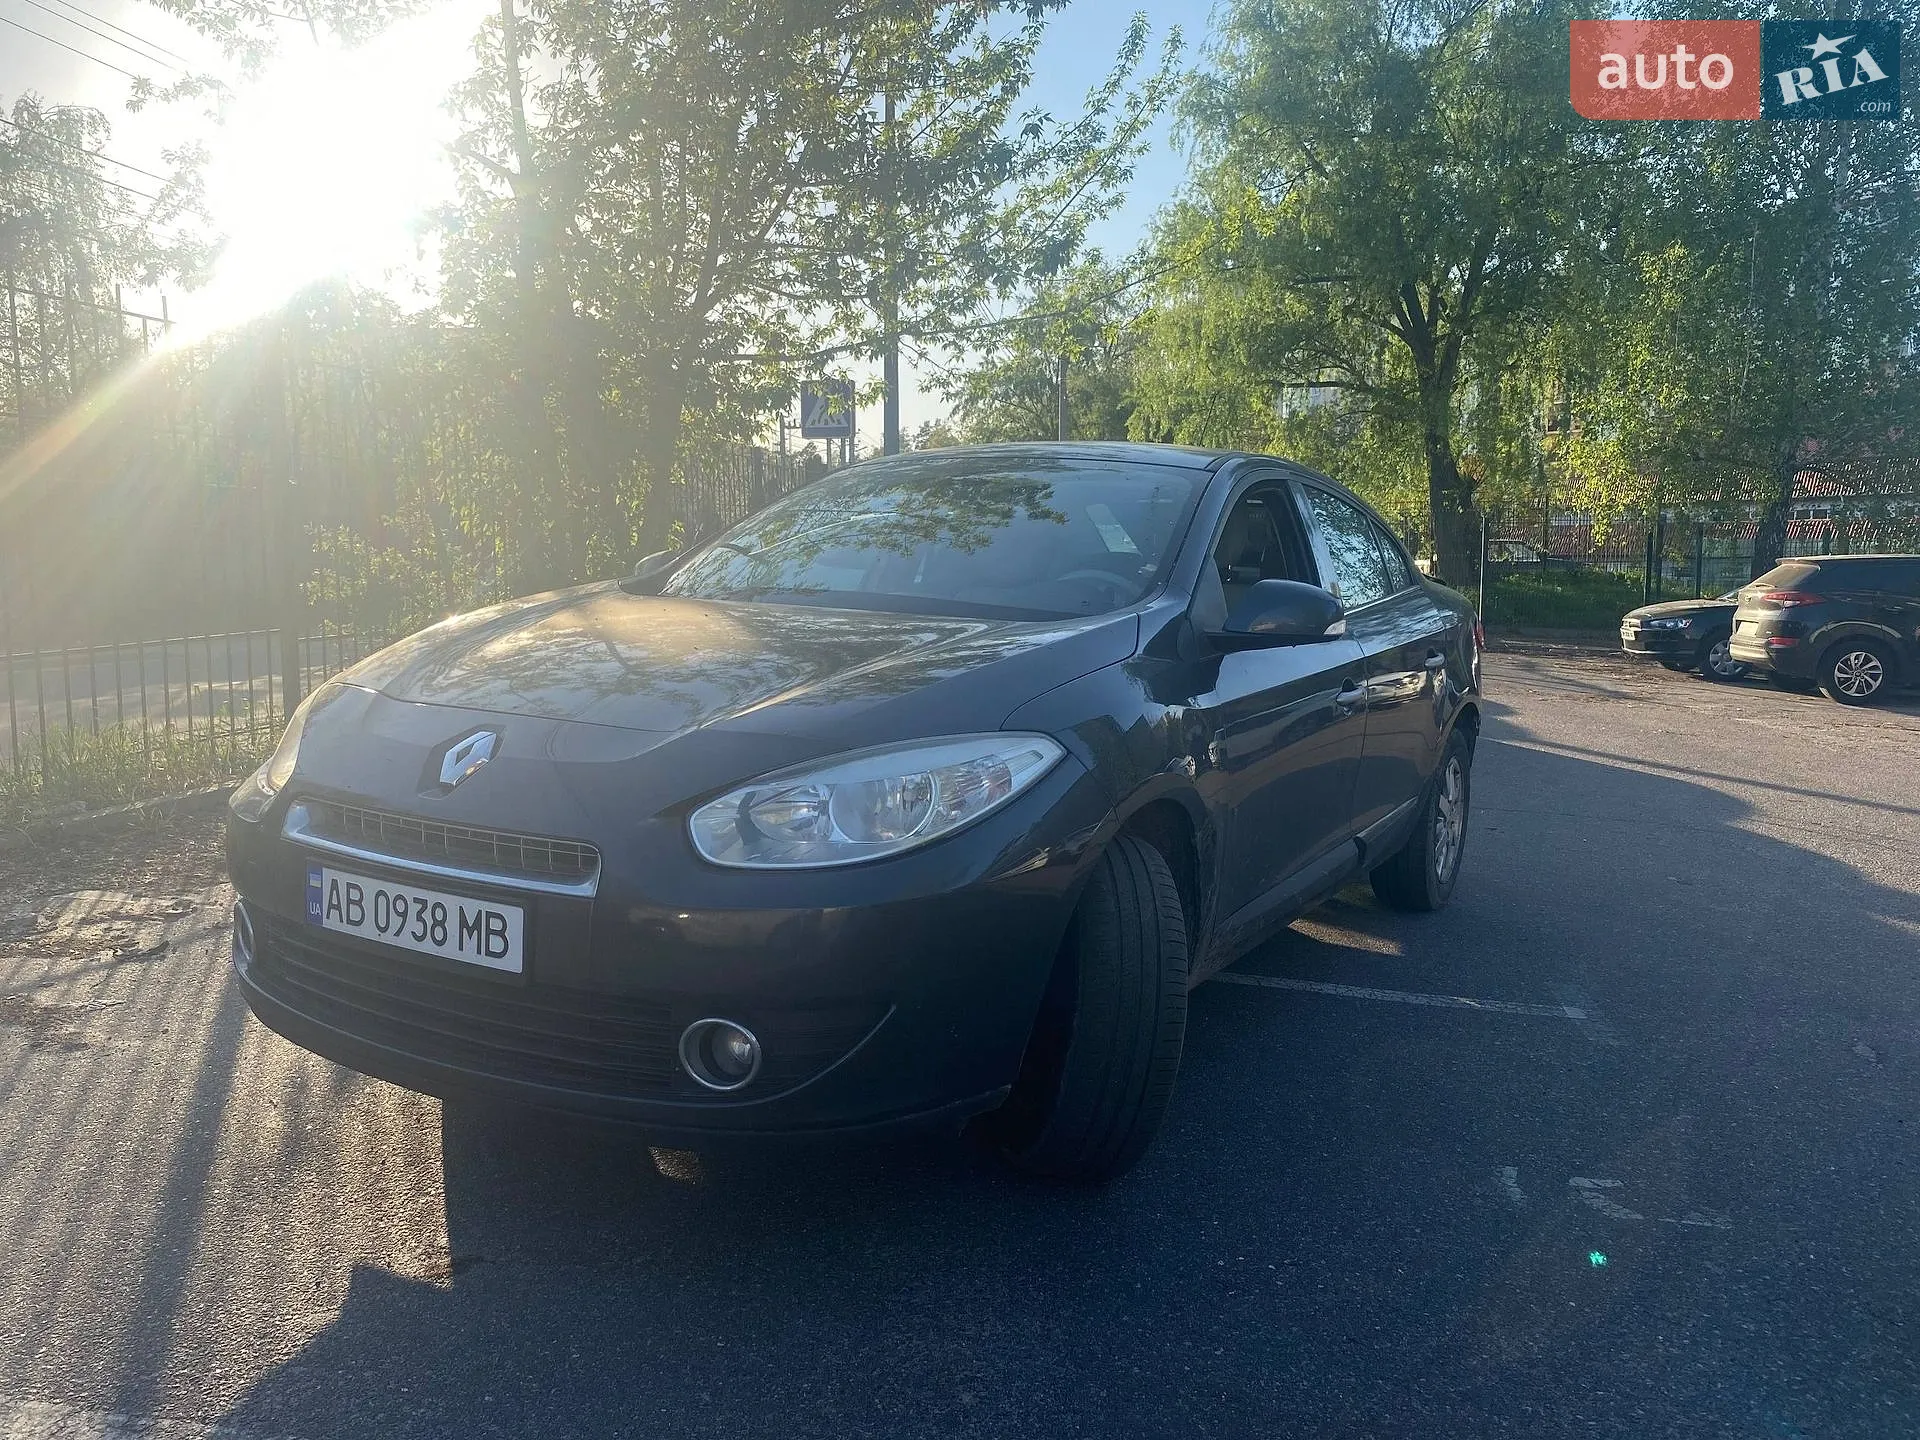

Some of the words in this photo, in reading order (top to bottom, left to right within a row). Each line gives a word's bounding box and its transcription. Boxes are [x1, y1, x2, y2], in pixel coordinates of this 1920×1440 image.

[309, 902, 322, 917] UA
[325, 878, 366, 927] AB
[374, 889, 448, 947] 0938
[458, 905, 509, 959] MB
